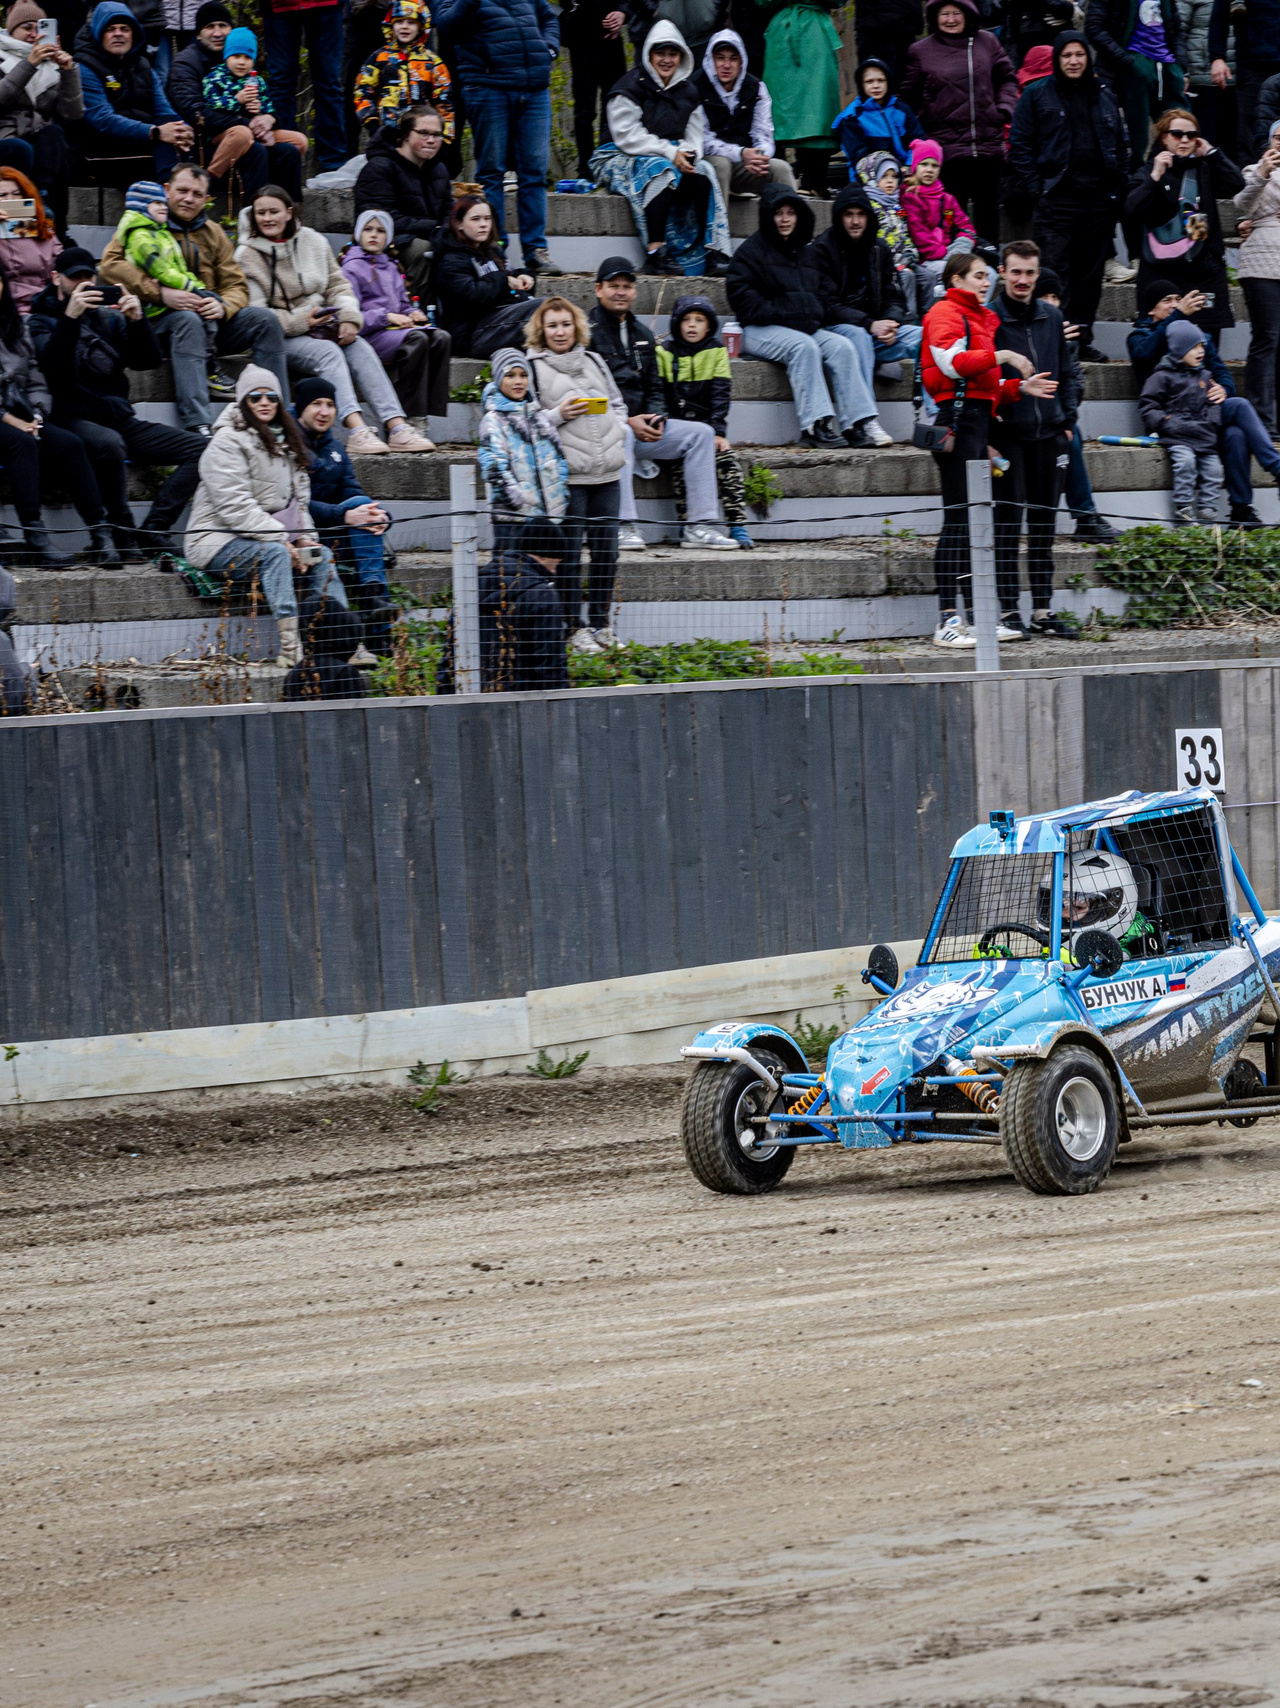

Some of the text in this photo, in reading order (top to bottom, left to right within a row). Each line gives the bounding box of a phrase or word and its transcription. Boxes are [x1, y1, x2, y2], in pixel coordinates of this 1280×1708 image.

[1180, 735, 1221, 787] 33
[1081, 977, 1166, 1009] БУНЧУК А.
